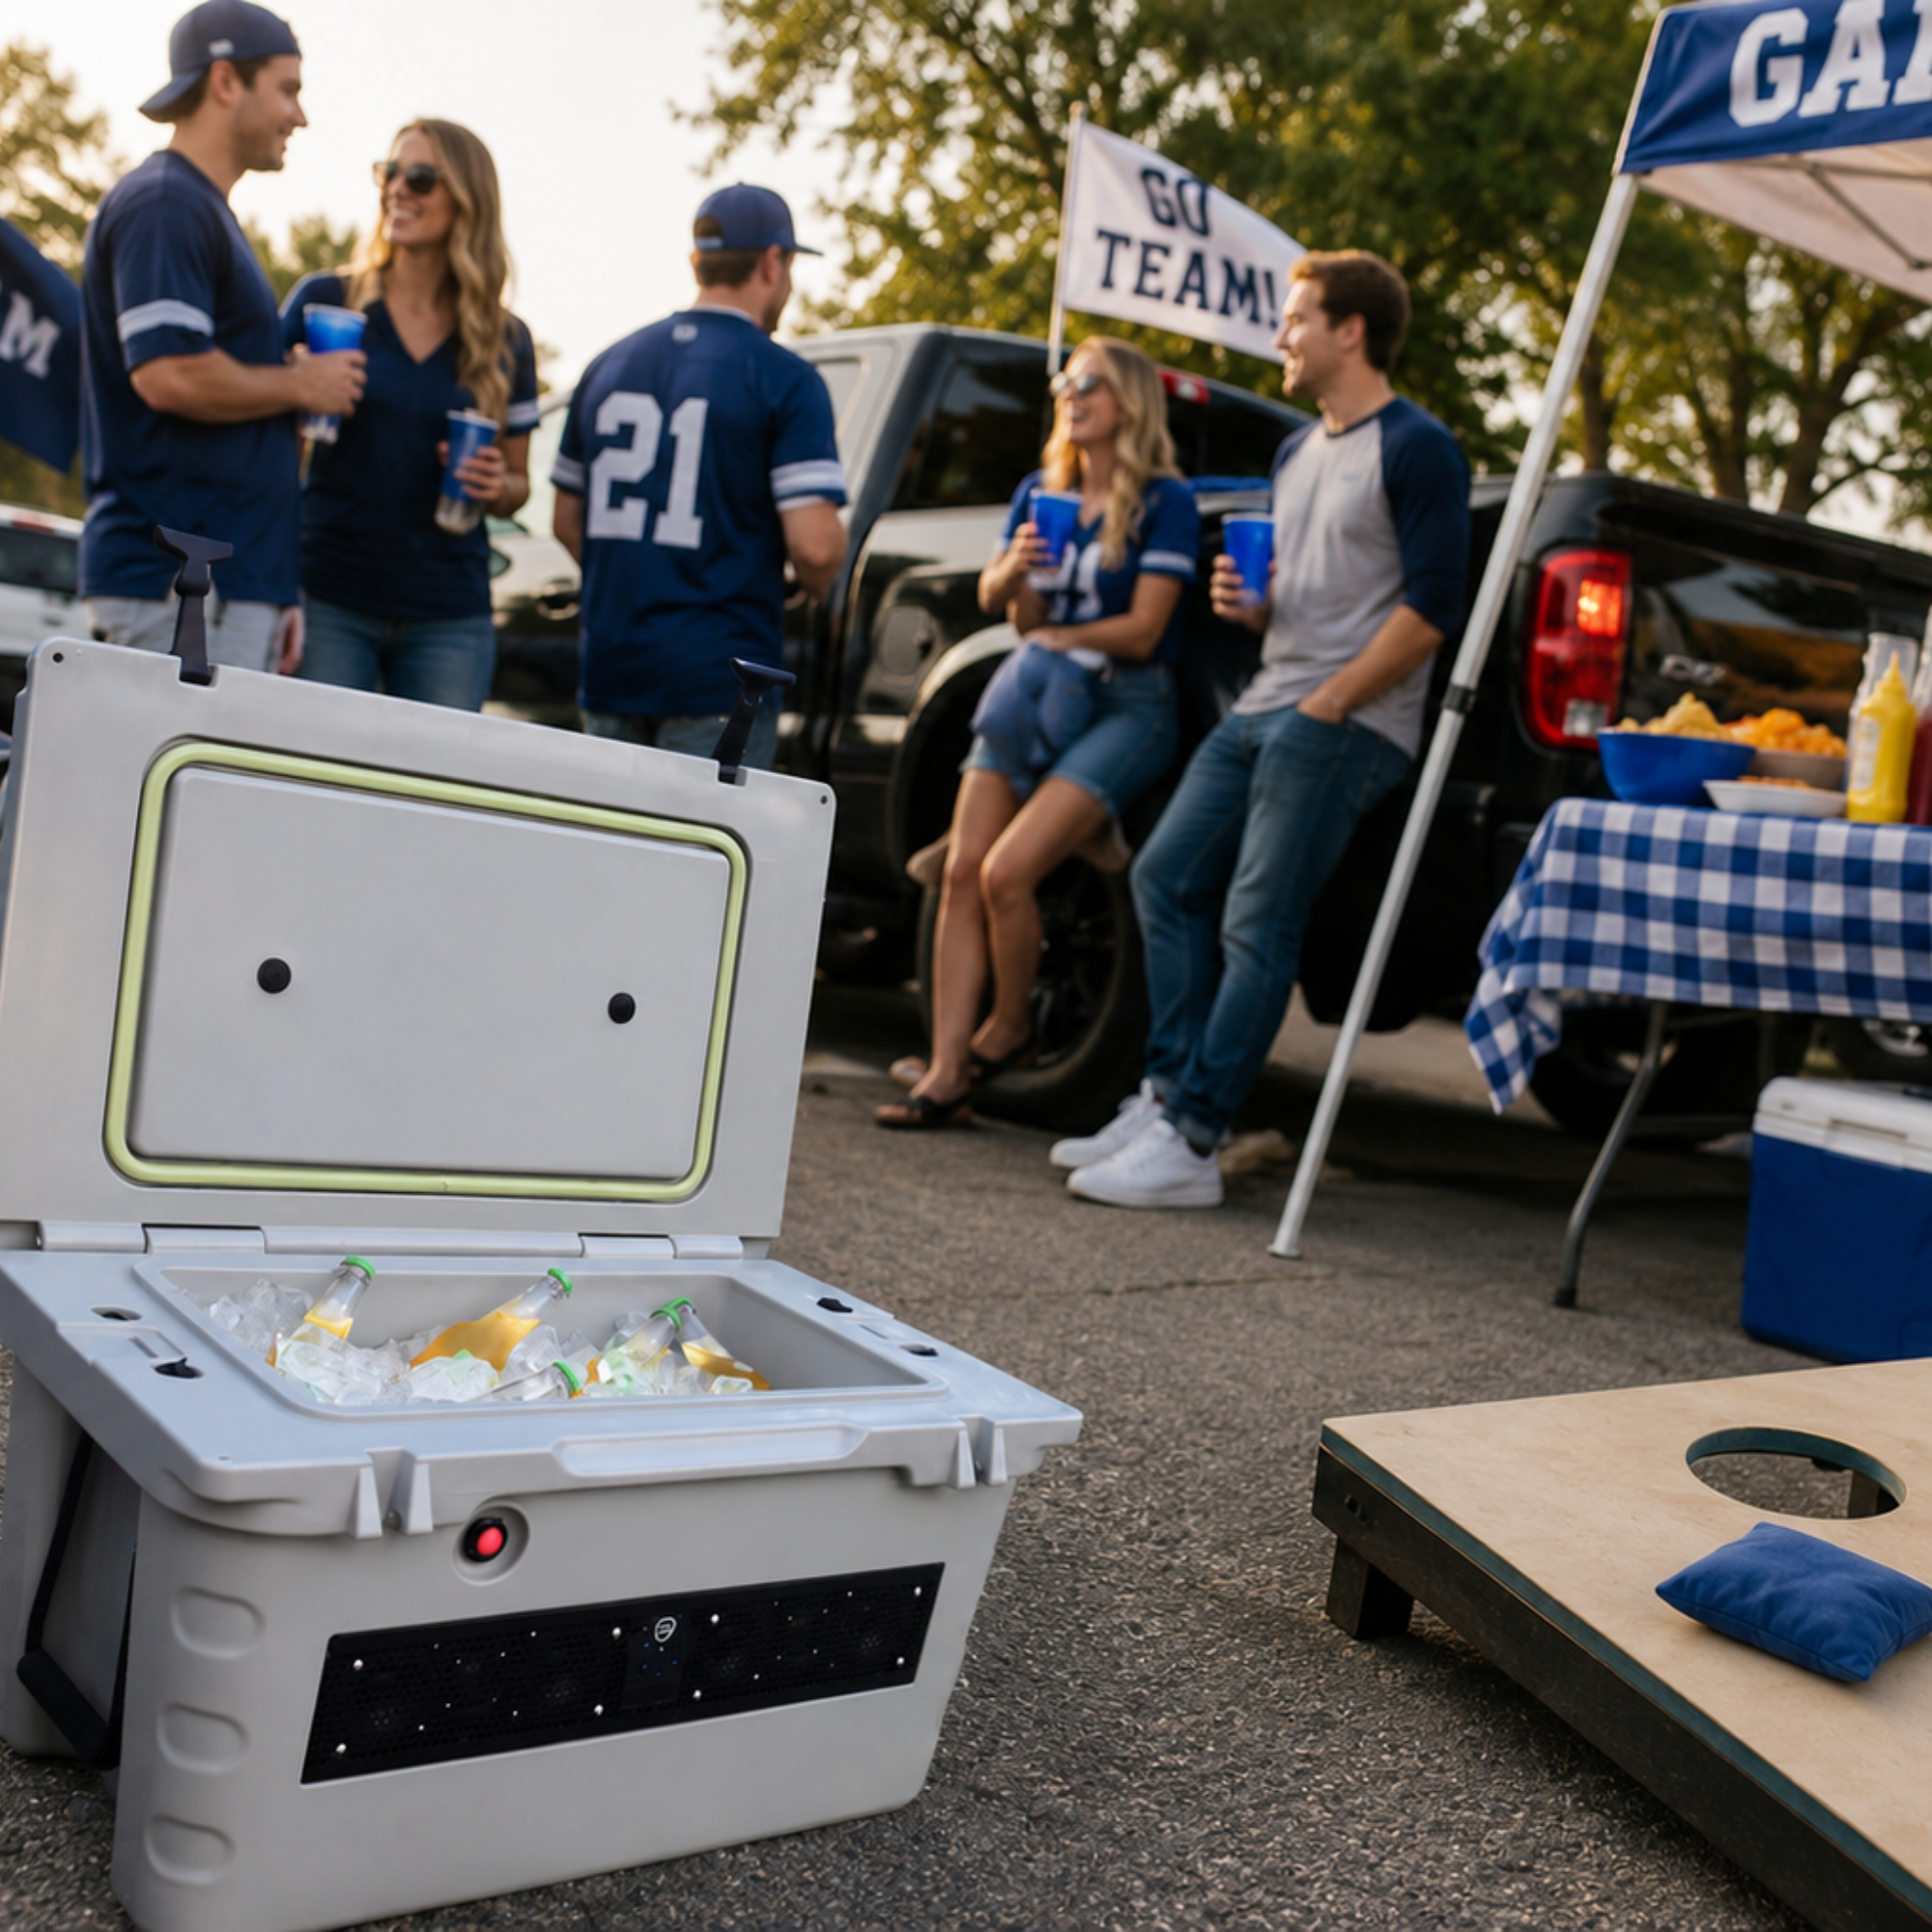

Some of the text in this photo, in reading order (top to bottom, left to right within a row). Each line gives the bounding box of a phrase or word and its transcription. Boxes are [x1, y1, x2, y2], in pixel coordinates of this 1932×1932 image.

[1140, 168, 1210, 236] GO
[1097, 228, 1279, 330] TEAM!
[586, 390, 708, 551] 21
